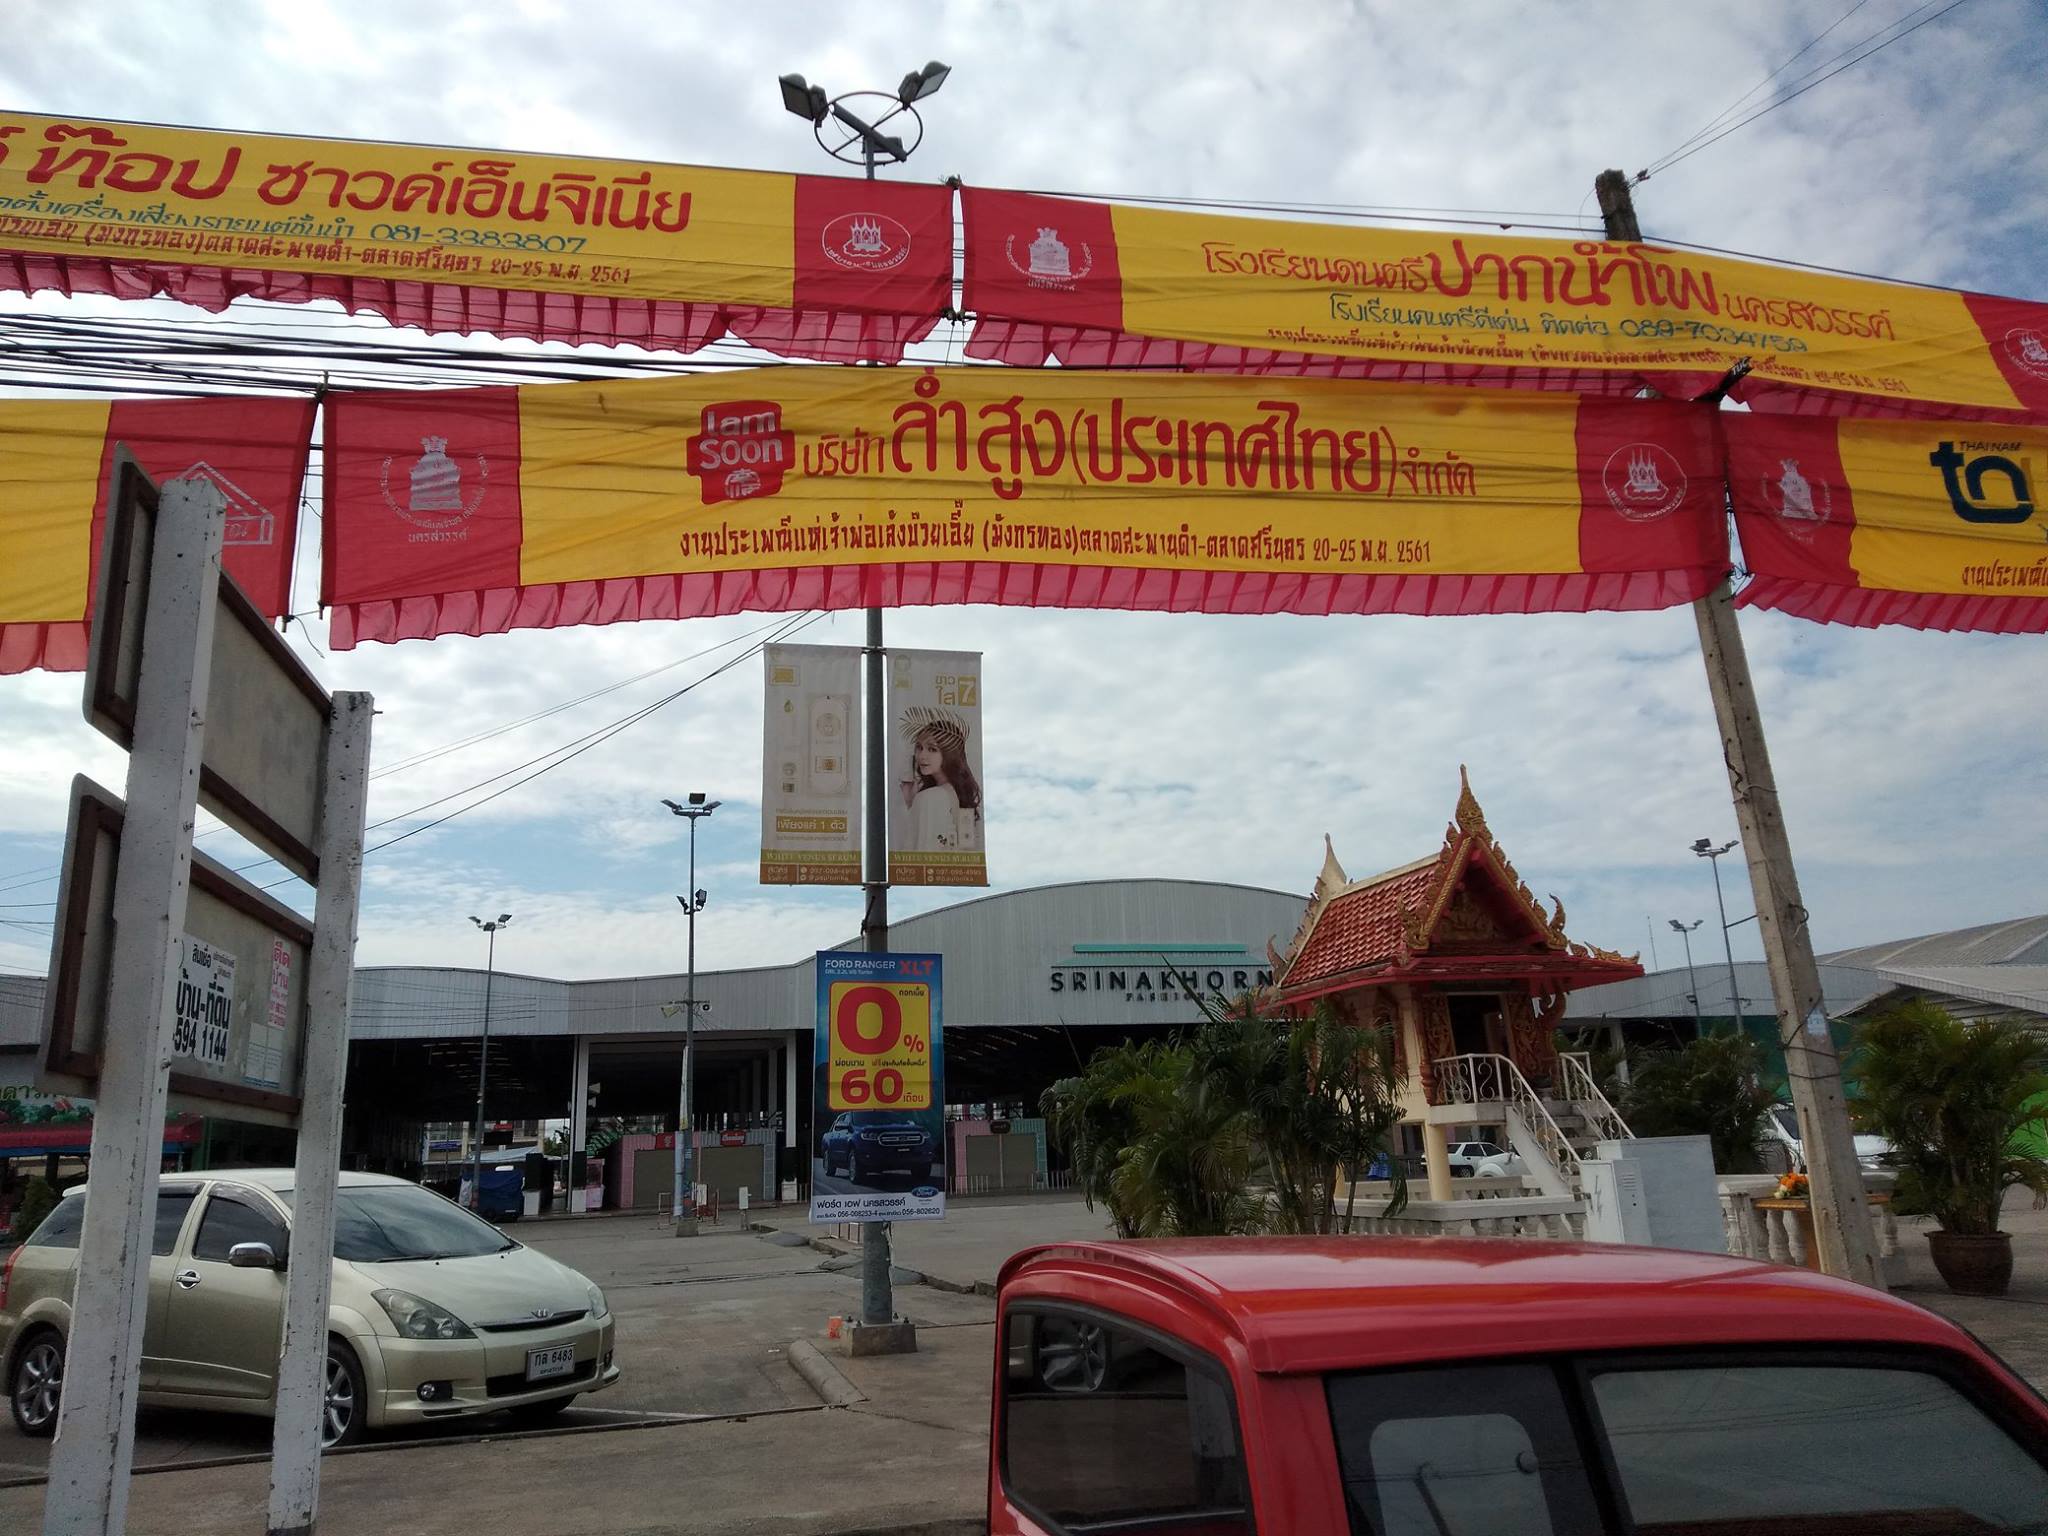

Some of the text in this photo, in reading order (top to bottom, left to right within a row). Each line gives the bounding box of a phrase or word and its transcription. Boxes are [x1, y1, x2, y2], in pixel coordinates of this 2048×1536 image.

[370, 223, 588, 255] 081-3383807
[590, 264, 631, 285] 2561
[1400, 446, 1477, 497] จำกัด
[1313, 537, 1357, 562] 20-25
[1397, 539, 1431, 564] 2561
[824, 959, 934, 976] FORD RANGER XLT
[1050, 970, 1273, 992] SRINAKHORN
[836, 986, 925, 1056] 0 %
[202, 1024, 228, 1063] 1144
[840, 1068, 904, 1105] 60
